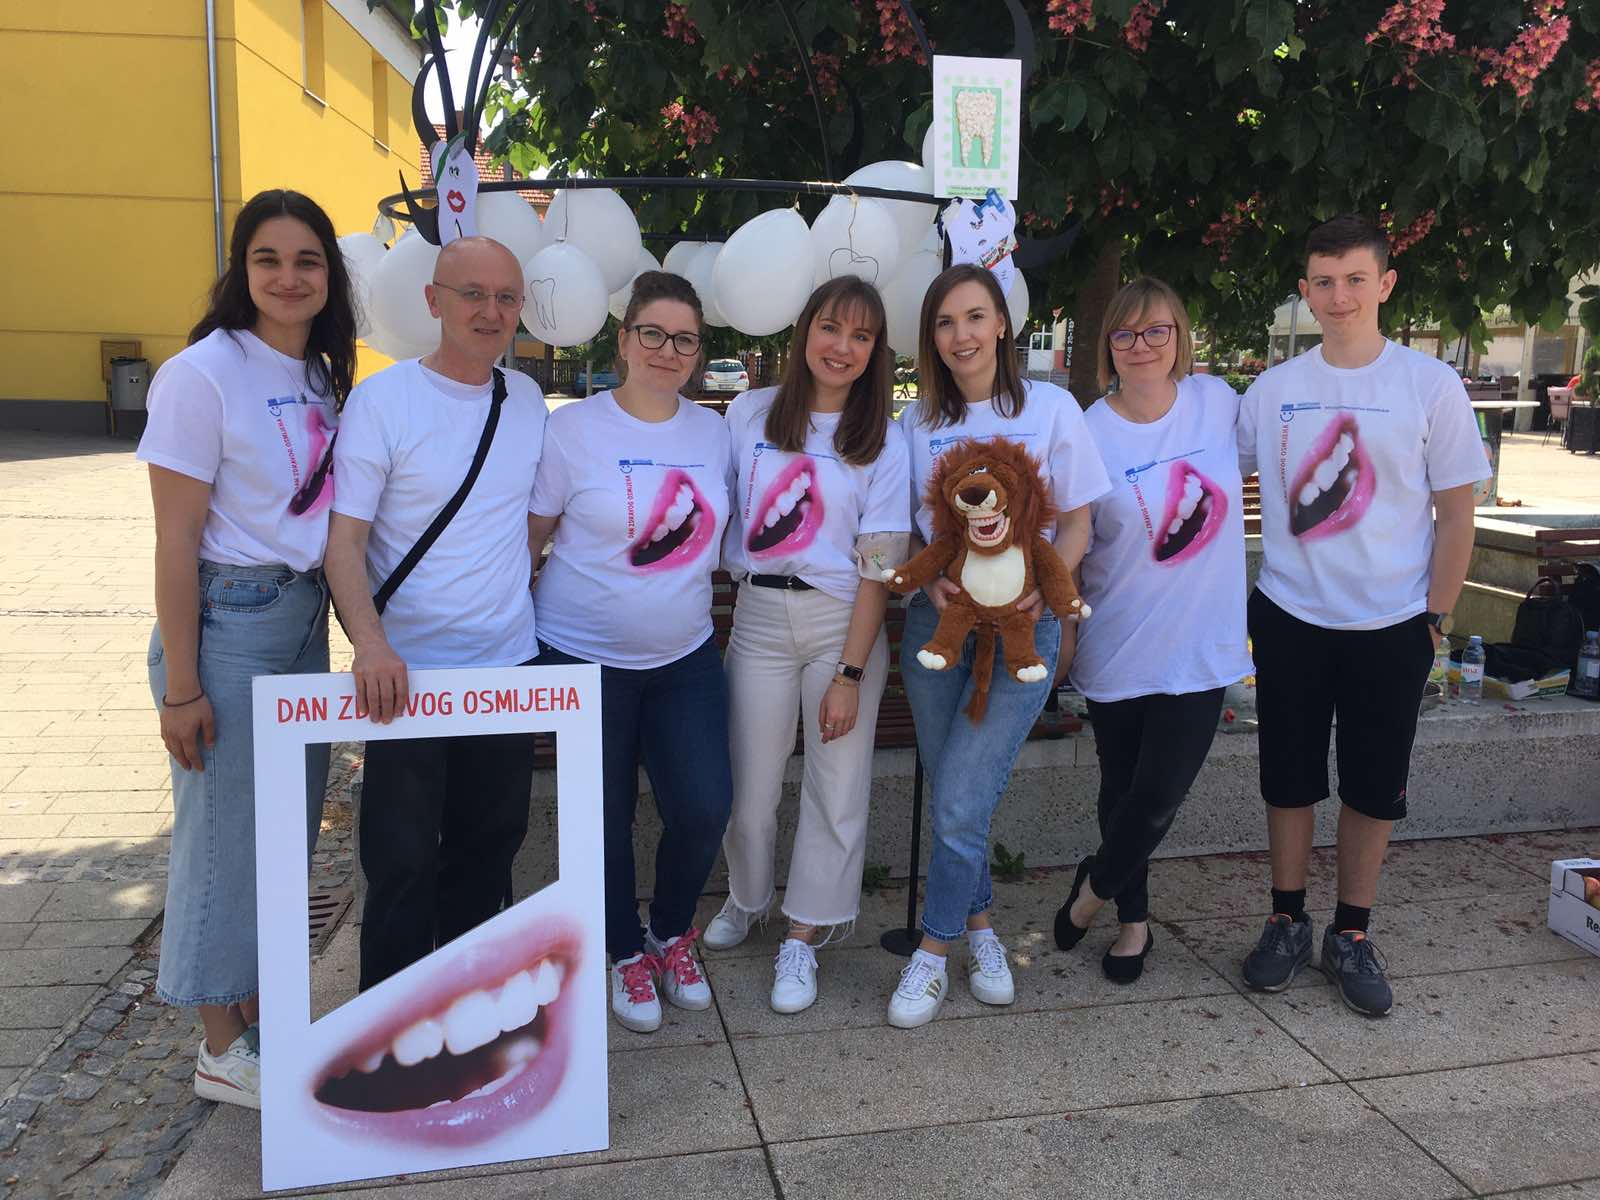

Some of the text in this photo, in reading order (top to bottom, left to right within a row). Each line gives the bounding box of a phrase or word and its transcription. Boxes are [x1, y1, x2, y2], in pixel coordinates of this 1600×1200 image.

[277, 687, 581, 723] DAN ZDVOG OSMIJEHA
[1586, 915, 1600, 935] Re
